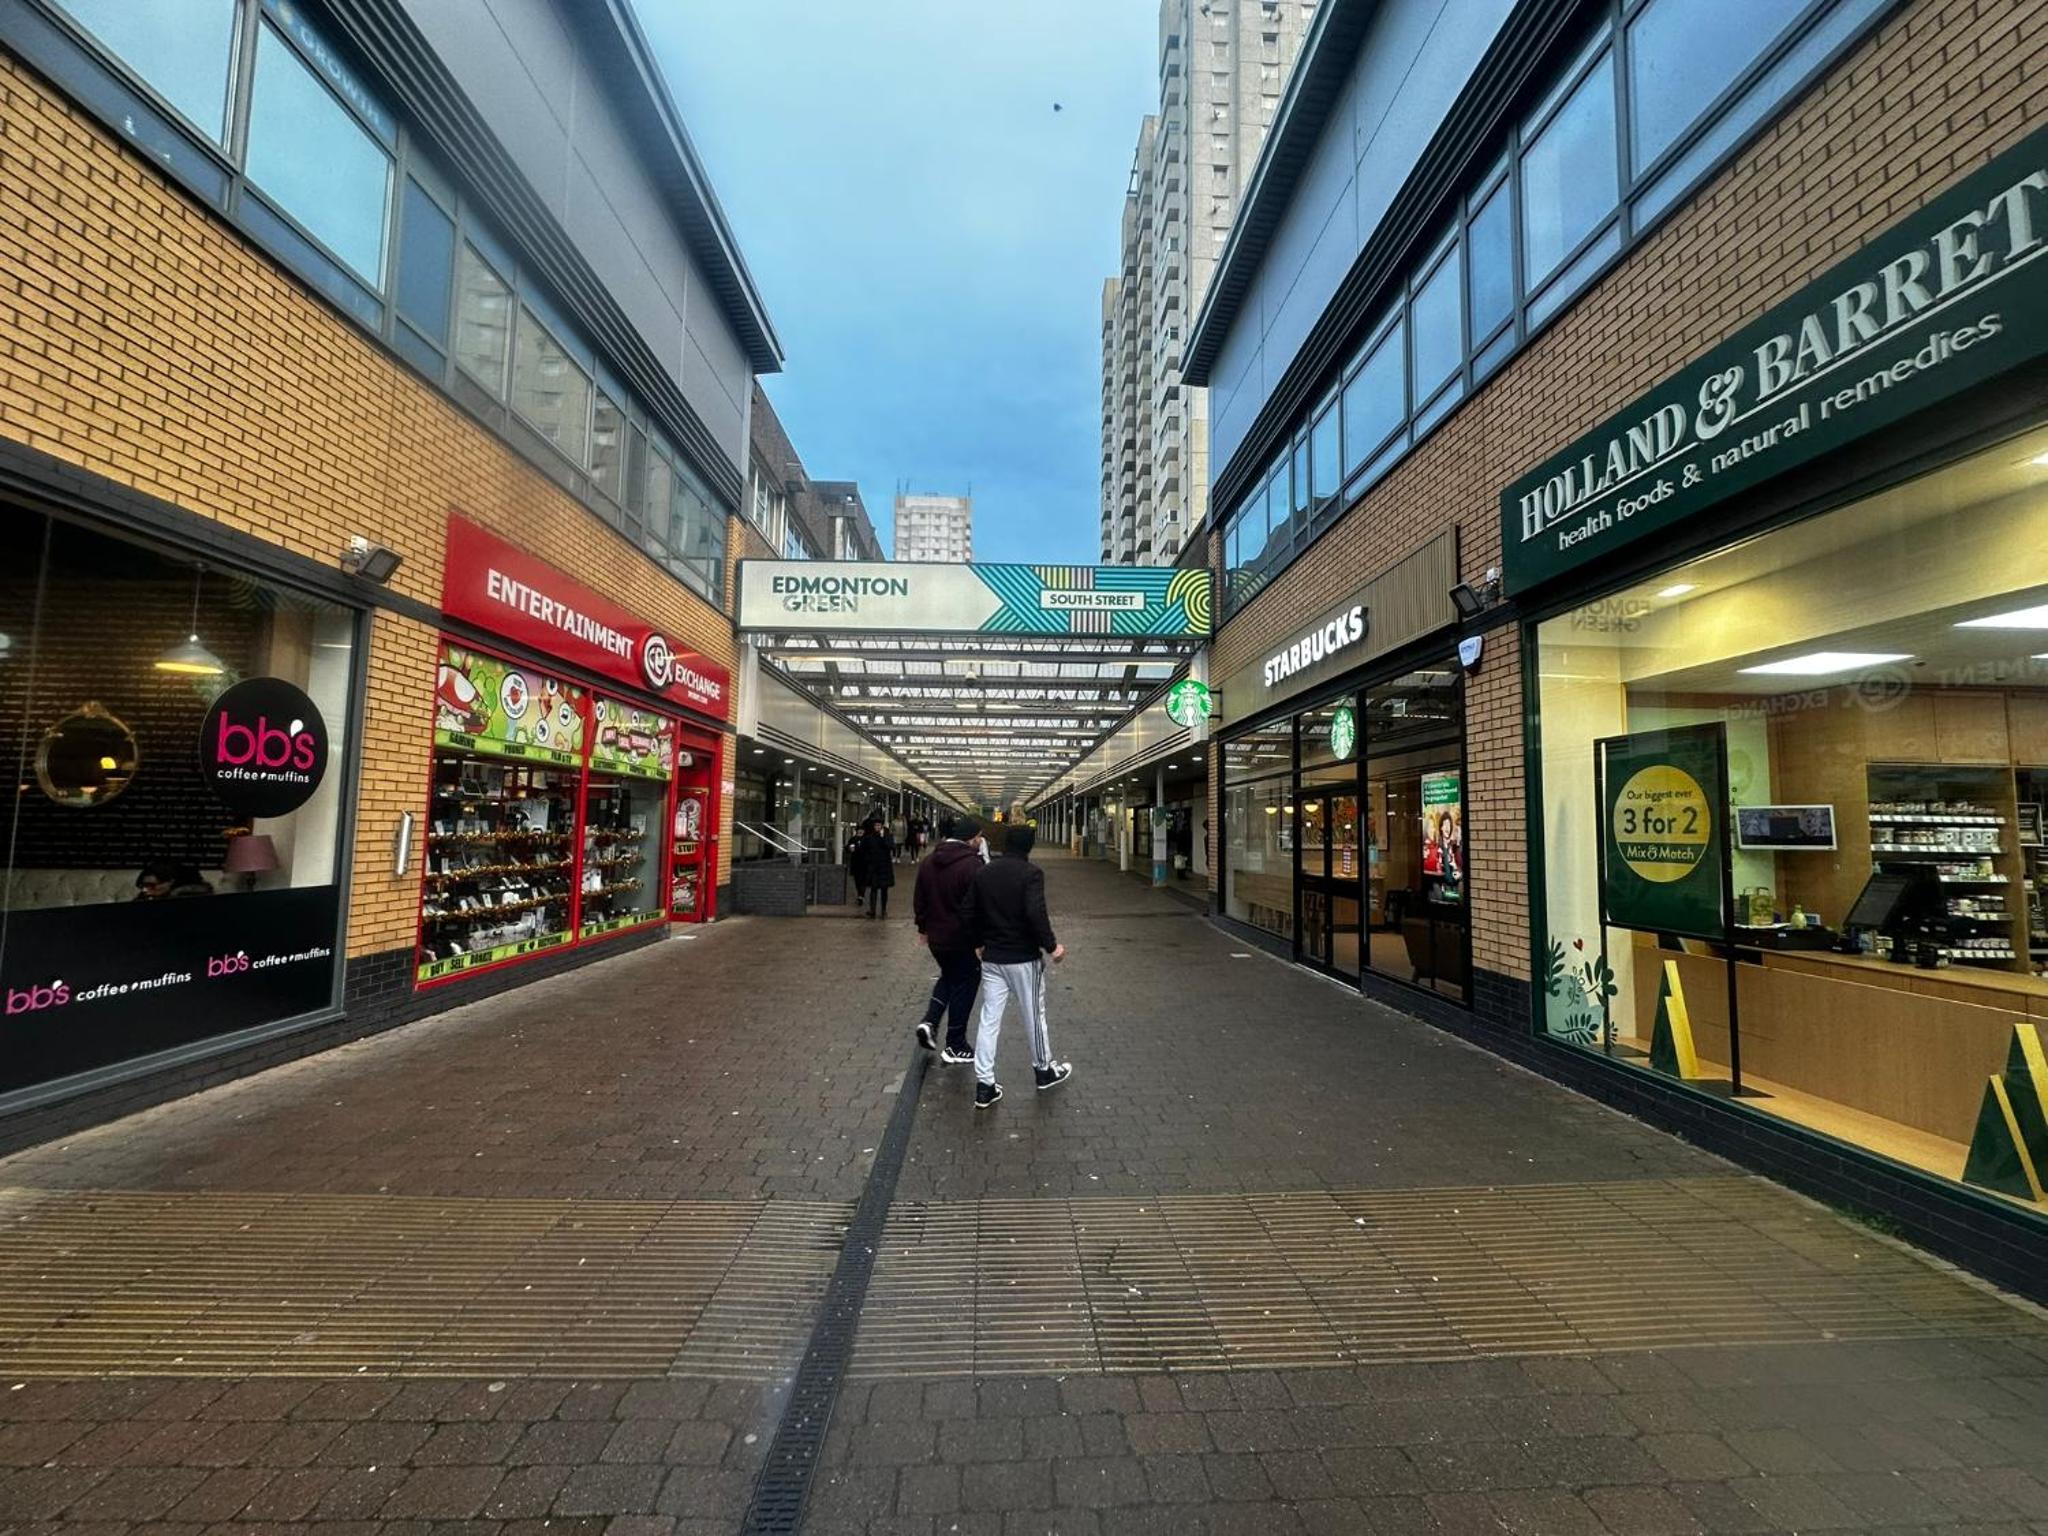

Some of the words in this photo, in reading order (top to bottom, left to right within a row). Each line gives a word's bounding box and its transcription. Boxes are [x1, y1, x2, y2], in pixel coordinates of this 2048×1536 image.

[1558, 509, 1613, 551] health
[1616, 478, 1675, 522] foods
[1681, 463, 1704, 487] &
[1711, 403, 1810, 474] natural
[1820, 310, 2003, 422] remedies
[1519, 402, 1688, 544] HOLLAND
[1695, 364, 1746, 442] &
[772, 575, 908, 596] EDMONTON
[1050, 593, 1091, 606] SOUTH
[1094, 594, 1135, 607] STREET
[487, 567, 635, 661] ENTERTAINMENT
[782, 594, 859, 613] GREEN
[1265, 605, 1365, 688] STARBUCKS
[675, 663, 721, 701] EXCHANGE
[216, 710, 316, 770] bb's
[217, 767, 258, 781] coffee
[267, 769, 310, 783] muffins
[1627, 790, 1643, 801] Our
[1645, 789, 1673, 802] biggest
[1675, 790, 1693, 799] ever
[1623, 808, 1637, 834] 3
[1642, 806, 1677, 834] for
[1682, 806, 1698, 834] 2
[208, 950, 250, 977] bb's
[252, 953, 288, 970] coffee
[294, 946, 331, 962] muffins
[450, 957, 465, 970] SELL
[5, 979, 70, 1014] bb's
[76, 981, 128, 1002] coffee
[139, 970, 192, 990] muffins
